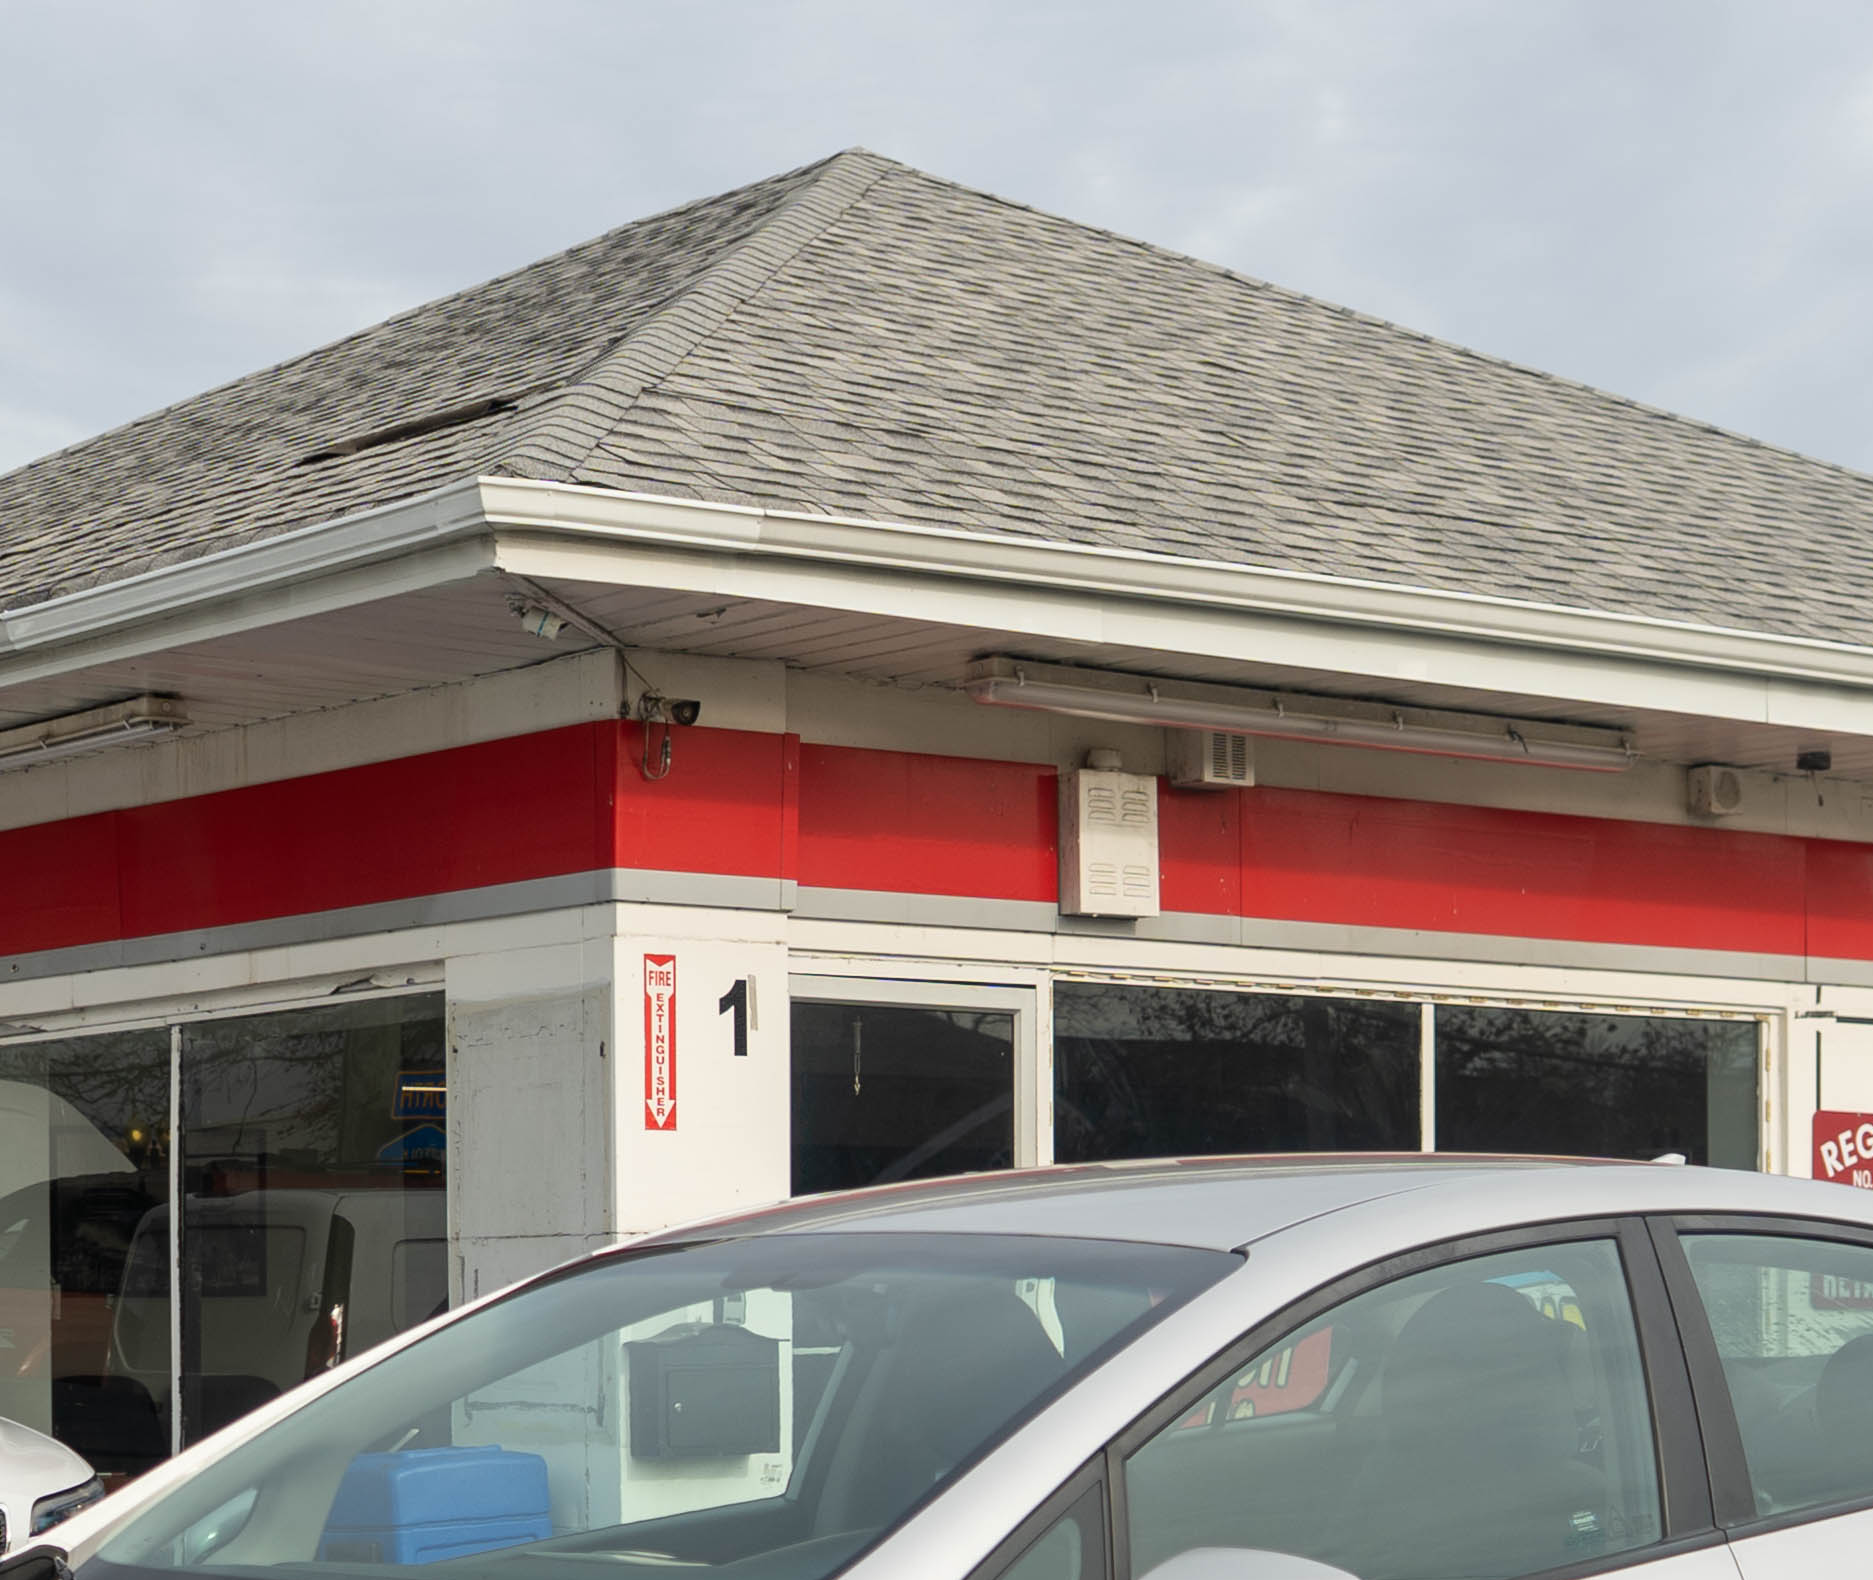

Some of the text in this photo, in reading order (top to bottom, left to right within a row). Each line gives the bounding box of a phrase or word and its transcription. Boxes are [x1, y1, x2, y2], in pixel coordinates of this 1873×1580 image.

[648, 970, 672, 987] FIRE
[719, 979, 748, 1056] 1
[656, 993, 666, 1117] EXTINGUISHER
[1853, 1169, 1873, 1189] NO.
